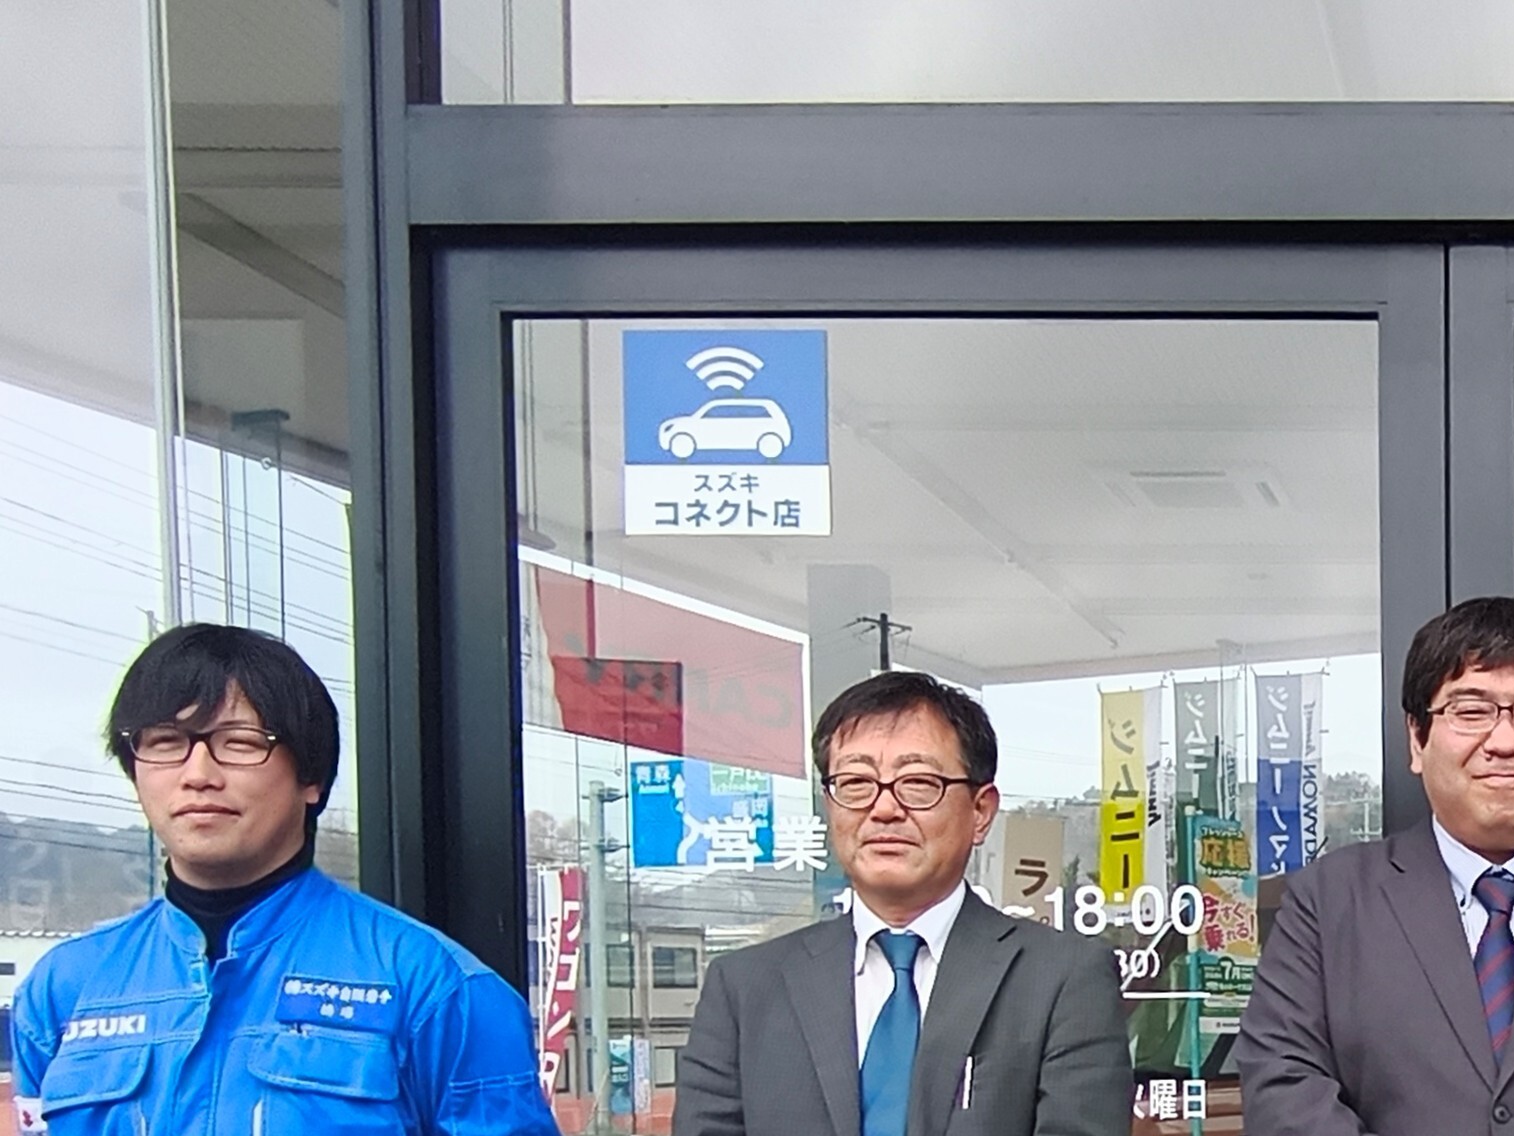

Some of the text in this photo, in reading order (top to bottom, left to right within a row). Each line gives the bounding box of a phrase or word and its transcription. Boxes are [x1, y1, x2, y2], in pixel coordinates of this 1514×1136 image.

[694, 472, 760, 494] スズキ
[654, 498, 801, 529] コネクト店
[704, 815, 829, 873] 営業
[62, 1014, 147, 1042] UZUKI
